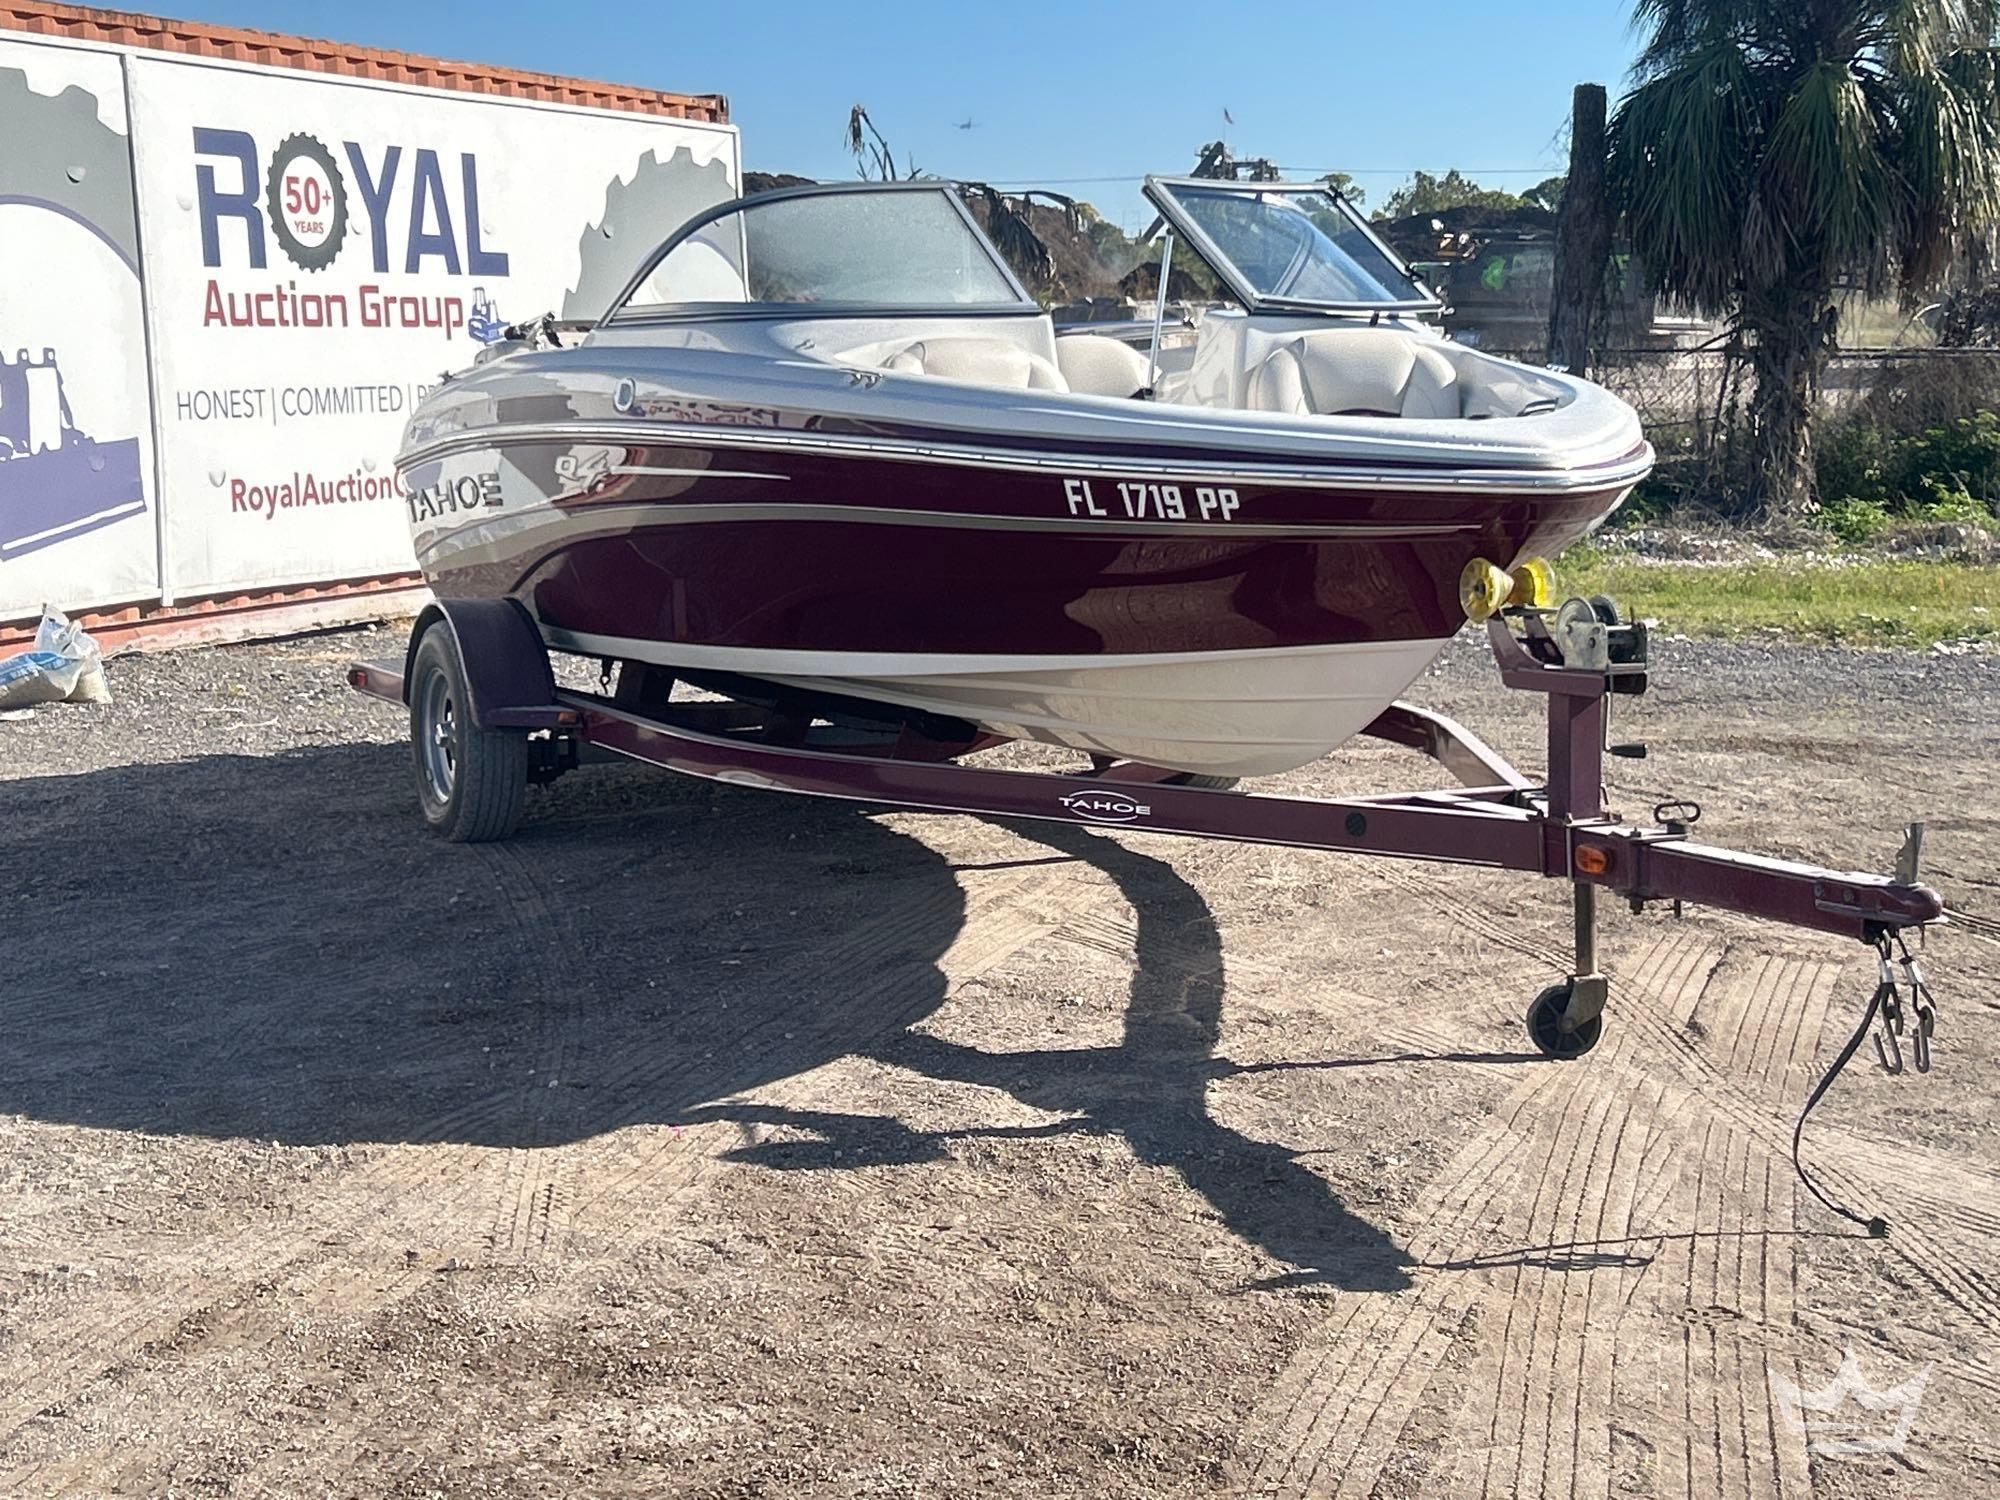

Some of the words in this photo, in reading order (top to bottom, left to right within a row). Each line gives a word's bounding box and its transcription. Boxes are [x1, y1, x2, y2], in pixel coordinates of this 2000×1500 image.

[192, 126, 510, 277] ROYAL
[286, 175, 332, 215] 50+
[294, 220, 325, 235] YEARS
[203, 279, 349, 328] Auction
[359, 285, 464, 341] Group
[176, 389, 266, 421] HONEST
[281, 384, 403, 417] COMMITTED
[405, 472, 504, 523] TAHOE
[1063, 479, 1107, 516] FL
[1117, 482, 1187, 520] 1719
[1195, 487, 1240, 521] PP
[1058, 796, 1151, 816] TAHOE
